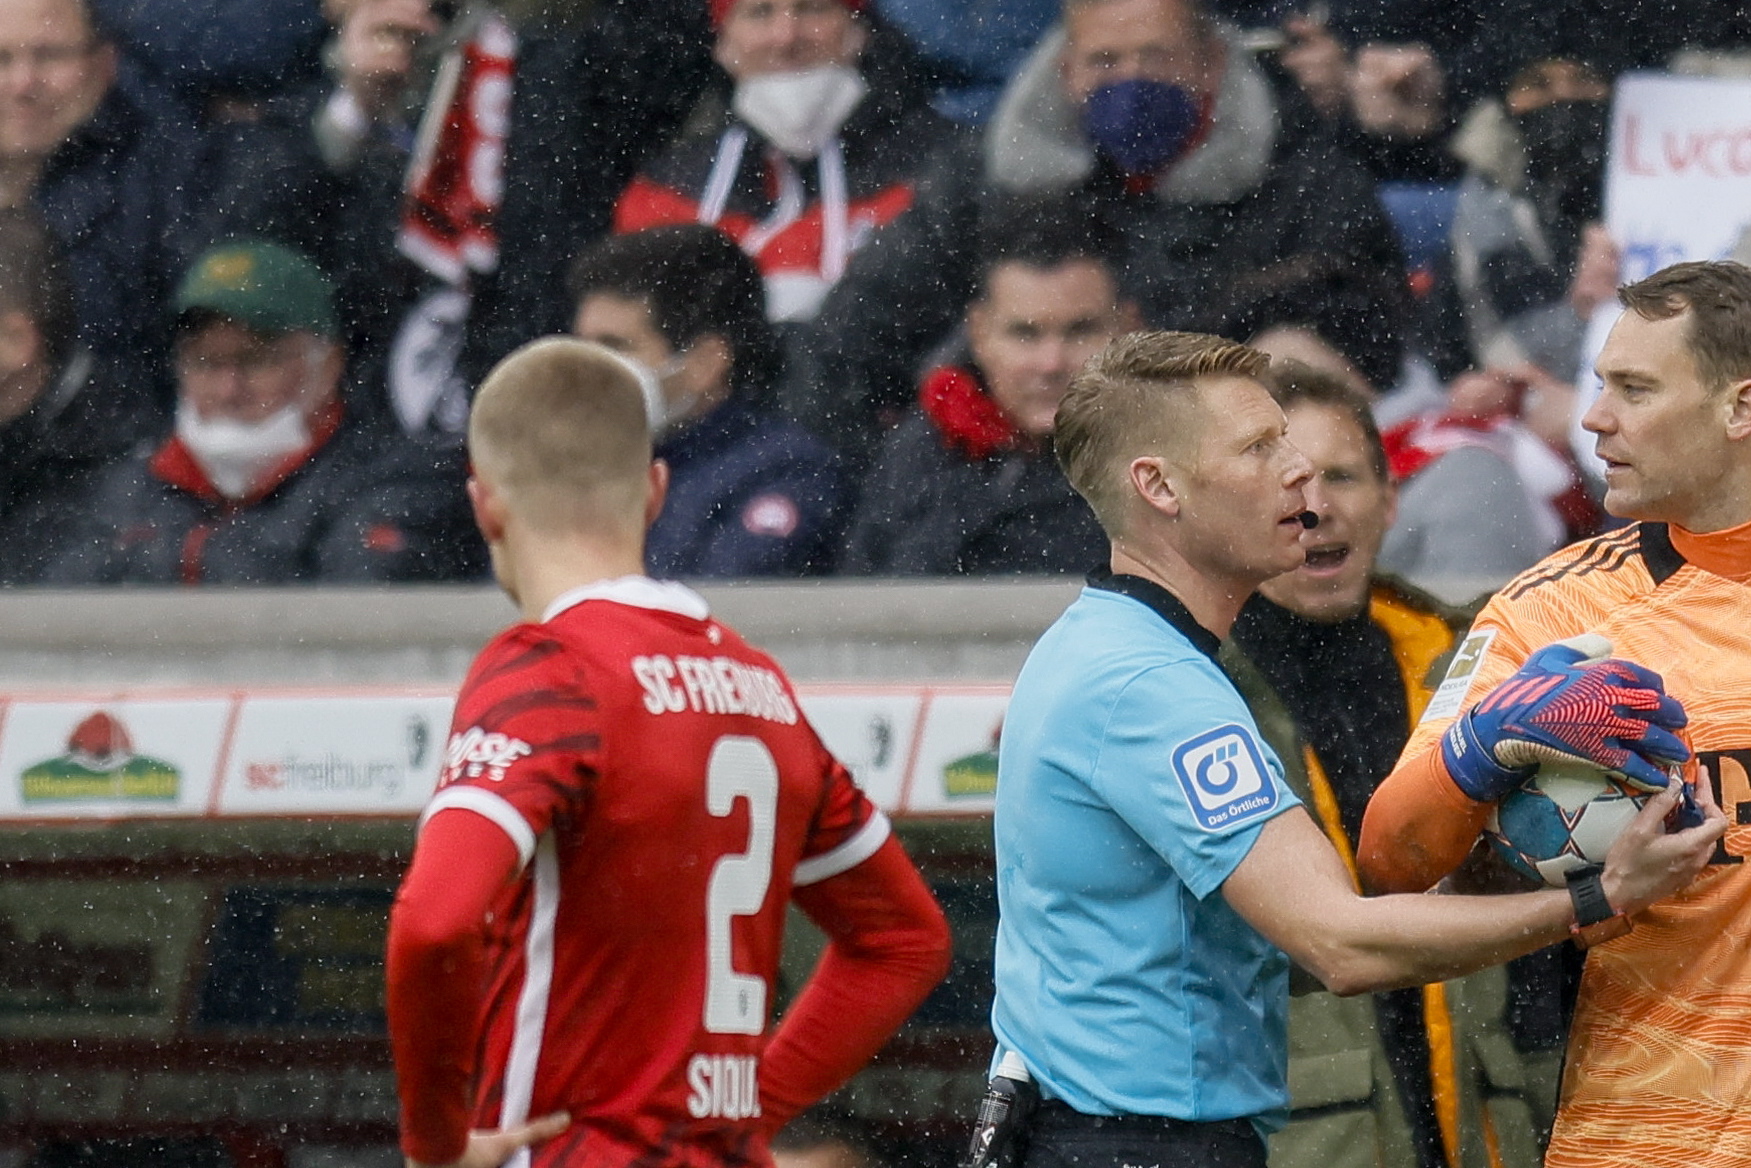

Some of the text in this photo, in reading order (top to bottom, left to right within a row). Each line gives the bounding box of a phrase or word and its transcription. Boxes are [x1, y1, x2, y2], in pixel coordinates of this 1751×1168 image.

[631, 654, 687, 715] SC
[1208, 796, 1270, 827] Das Örtliche
[705, 735, 778, 1036] 2
